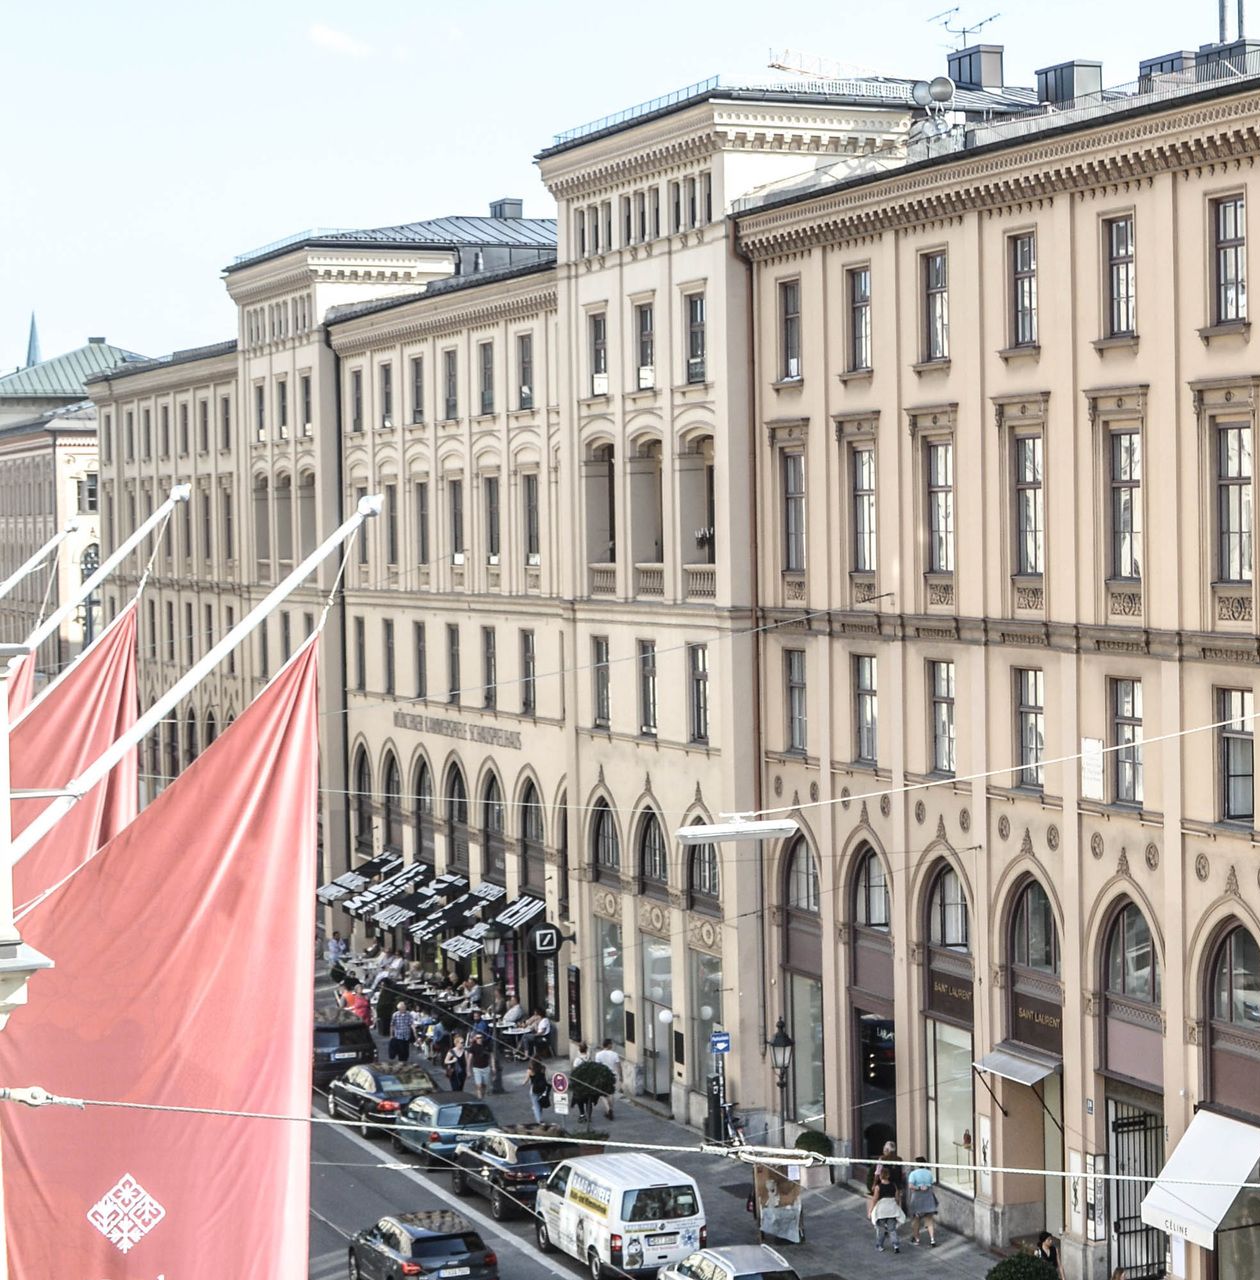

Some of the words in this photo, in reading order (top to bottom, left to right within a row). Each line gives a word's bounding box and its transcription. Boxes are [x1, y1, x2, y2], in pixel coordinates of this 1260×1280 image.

[934, 981, 947, 993] SAINT
[948, 985, 972, 1000] LAURENT
[1018, 1007, 1033, 1019] SAINT
[1034, 1012, 1060, 1028] LAURENT
[1165, 1218, 1188, 1236] CÉLINE
